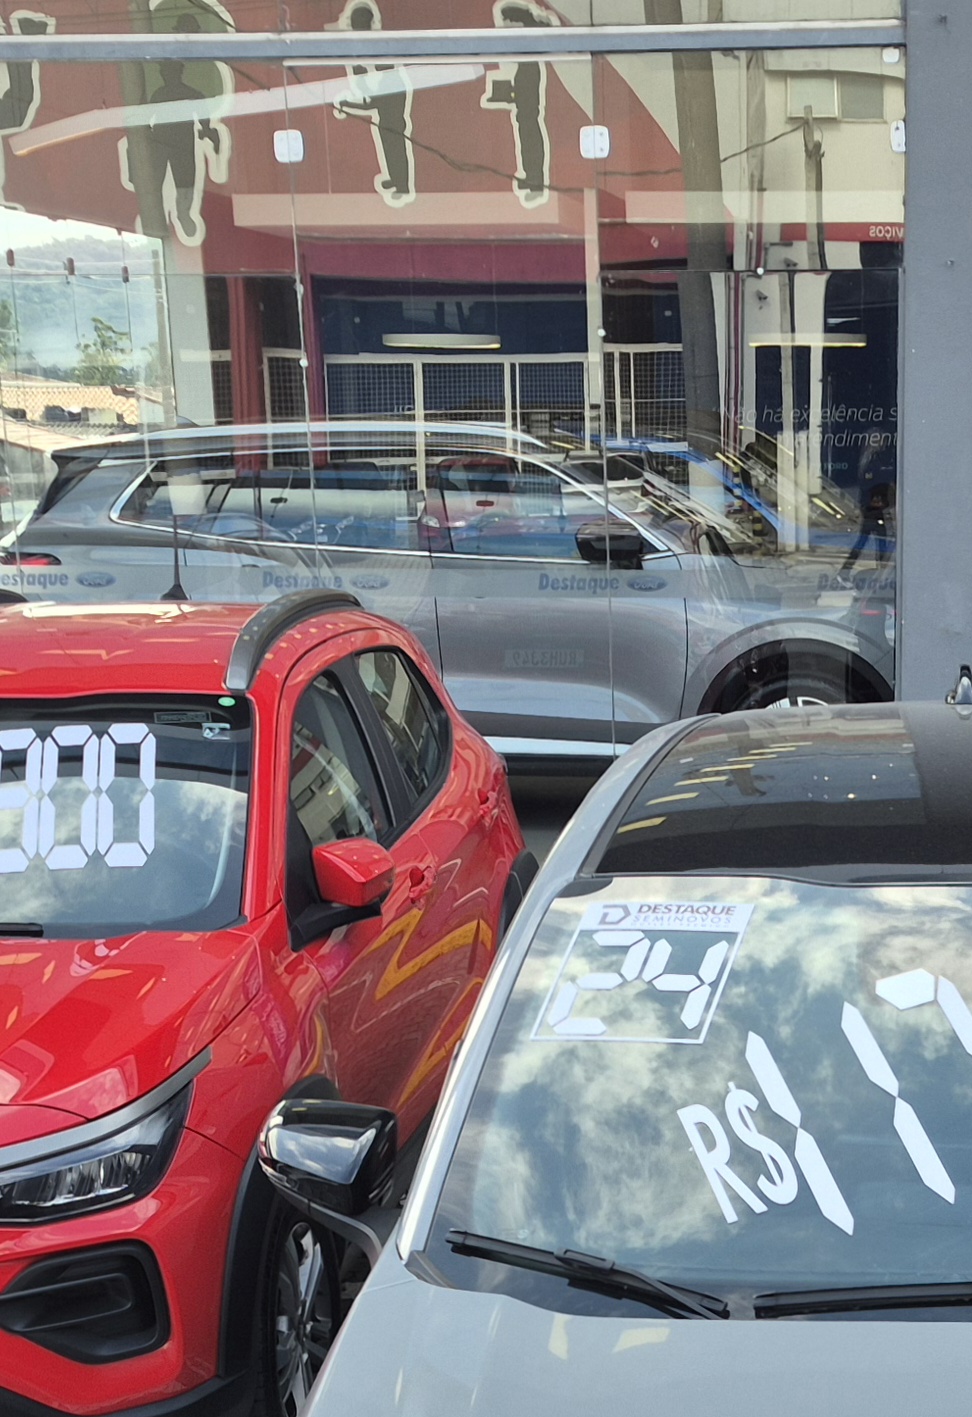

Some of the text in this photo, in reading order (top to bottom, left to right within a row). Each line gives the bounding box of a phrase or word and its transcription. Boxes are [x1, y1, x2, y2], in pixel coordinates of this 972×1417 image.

[537, 572, 620, 595] Destaque
[637, 903, 737, 916] DESTAQUE
[633, 914, 732, 924] SEMINOVOS
[547, 930, 730, 1036] 24
